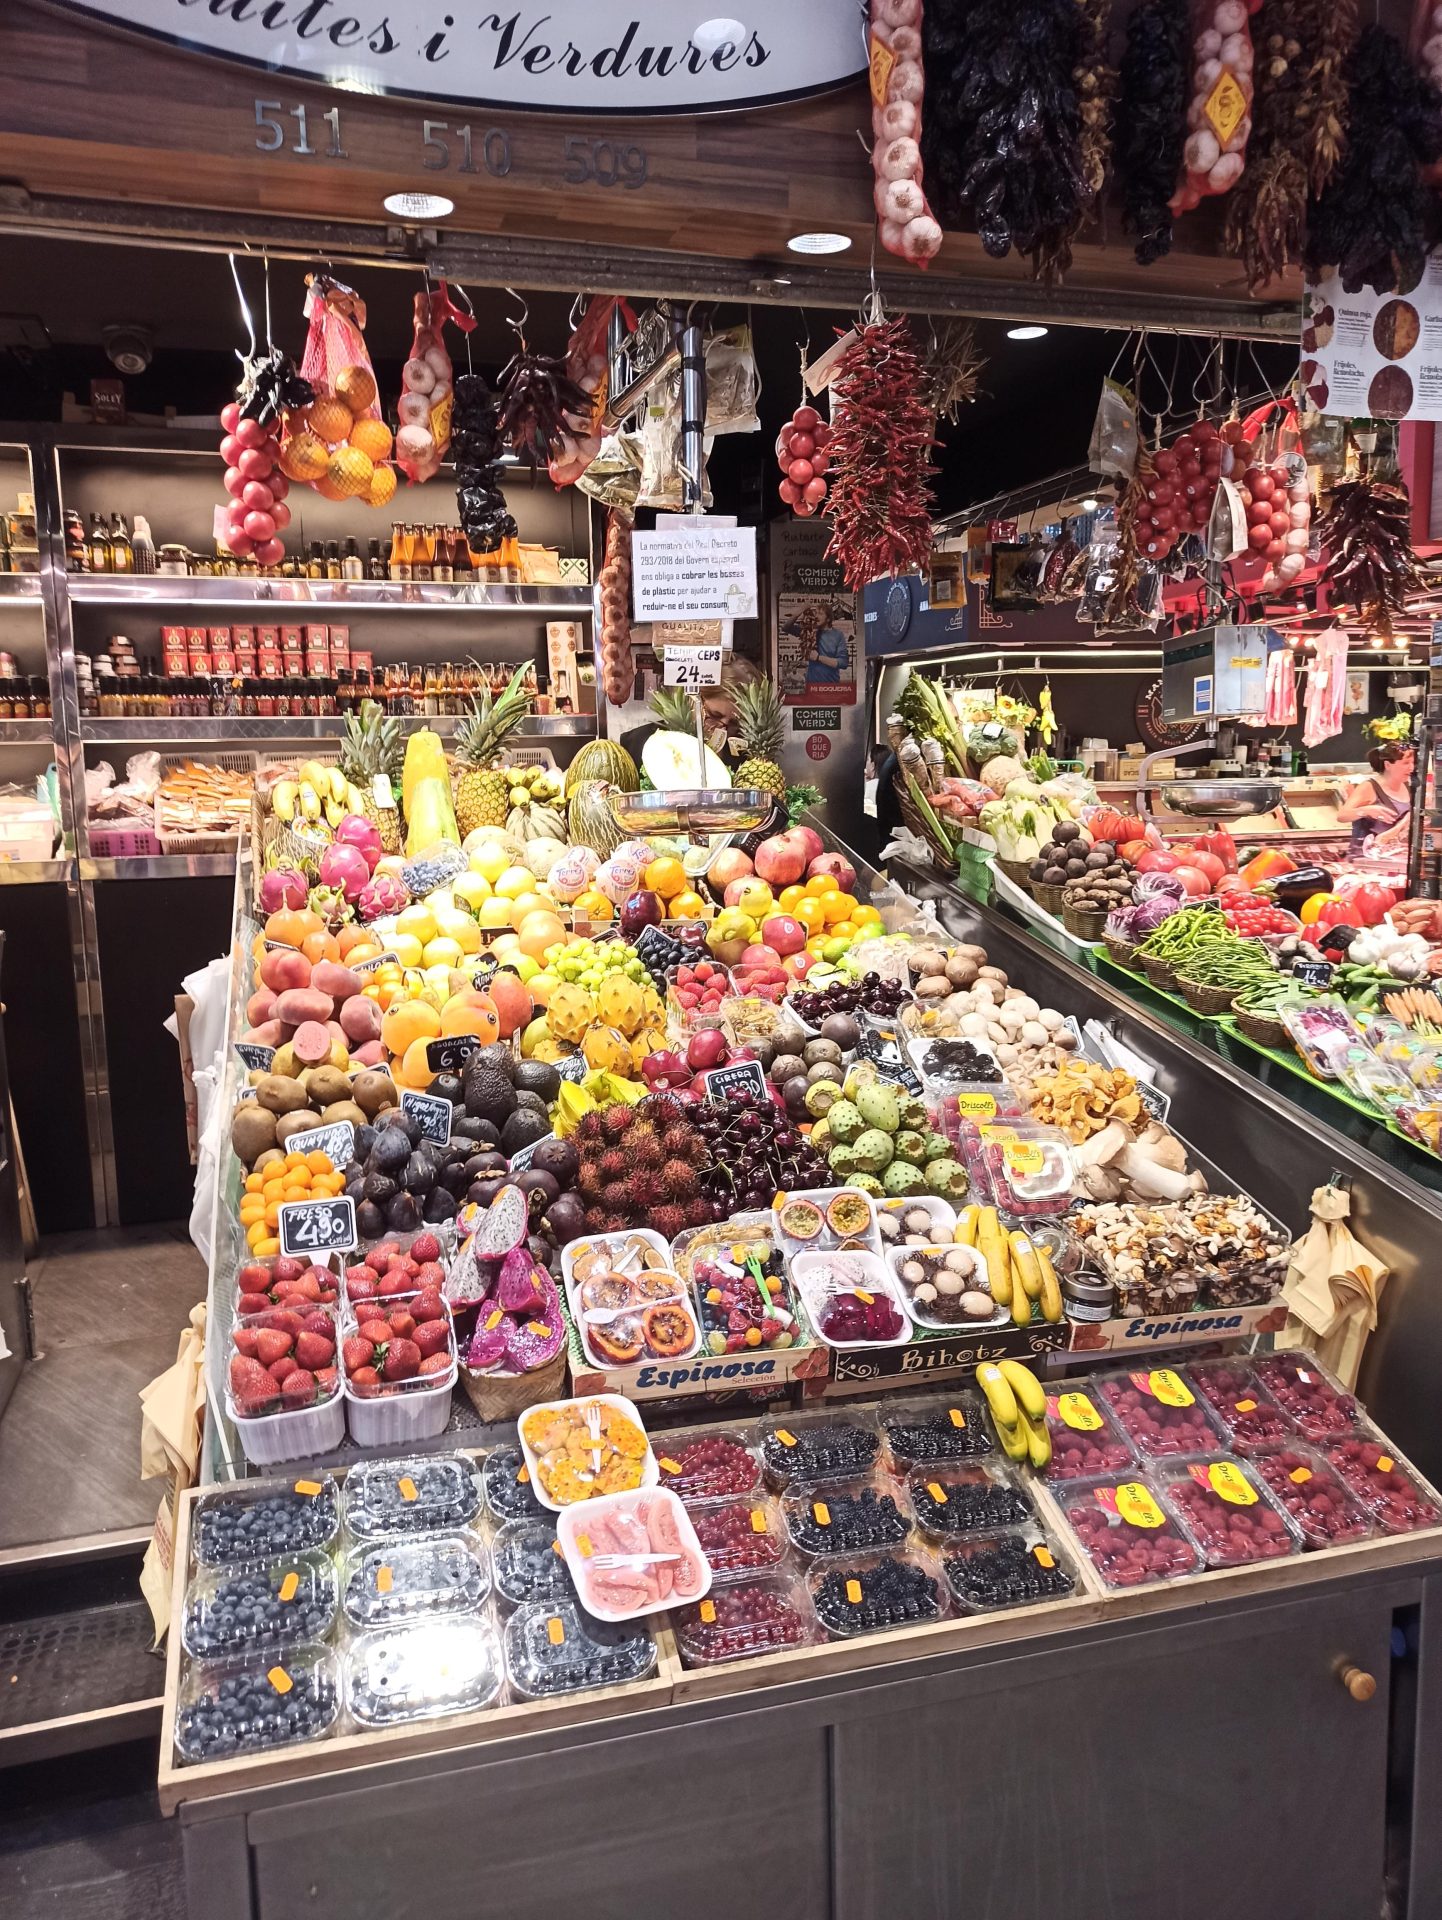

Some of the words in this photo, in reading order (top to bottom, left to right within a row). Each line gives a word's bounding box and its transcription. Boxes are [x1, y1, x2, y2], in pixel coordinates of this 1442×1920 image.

[423, 15, 454, 62] i
[478, 12, 771, 77] Verdures
[254, 99, 349, 159] 511
[422, 119, 512, 177] 510
[563, 135, 648, 190] 509
[640, 542, 648, 550] La
[641, 555, 673, 566] 293/2018
[674, 554, 685, 565] del
[686, 554, 709, 564] Govern
[641, 573, 653, 581] ens
[654, 571, 675, 582] obliga
[681, 570, 706, 580] cobrar
[707, 570, 718, 579] les
[797, 567, 840, 580] COMERÇ
[800, 577, 828, 586] VERD
[642, 587, 651, 596] de
[677, 588, 689, 597] per
[690, 586, 711, 597] ajudar
[642, 601, 677, 611] reduir-ne
[678, 601, 685, 610] el
[686, 601, 699, 610] seu
[697, 650, 721, 662] CEPS
[676, 665, 700, 684] 24
[795, 710, 838, 720] COMERÇ
[799, 719, 826, 727] VERD
[812, 735, 823, 743] BO
[812, 743, 827, 751] QUE
[812, 751, 825, 759] RIA
[715, 1070, 752, 1084] CIRERA
[960, 1100, 994, 1110] Driscoll's
[1125, 1314, 1243, 1340] Espinosa
[899, 1344, 1008, 1373] Bihotz
[636, 1359, 776, 1389] Espinosa
[731, 1374, 776, 1385] Selección
